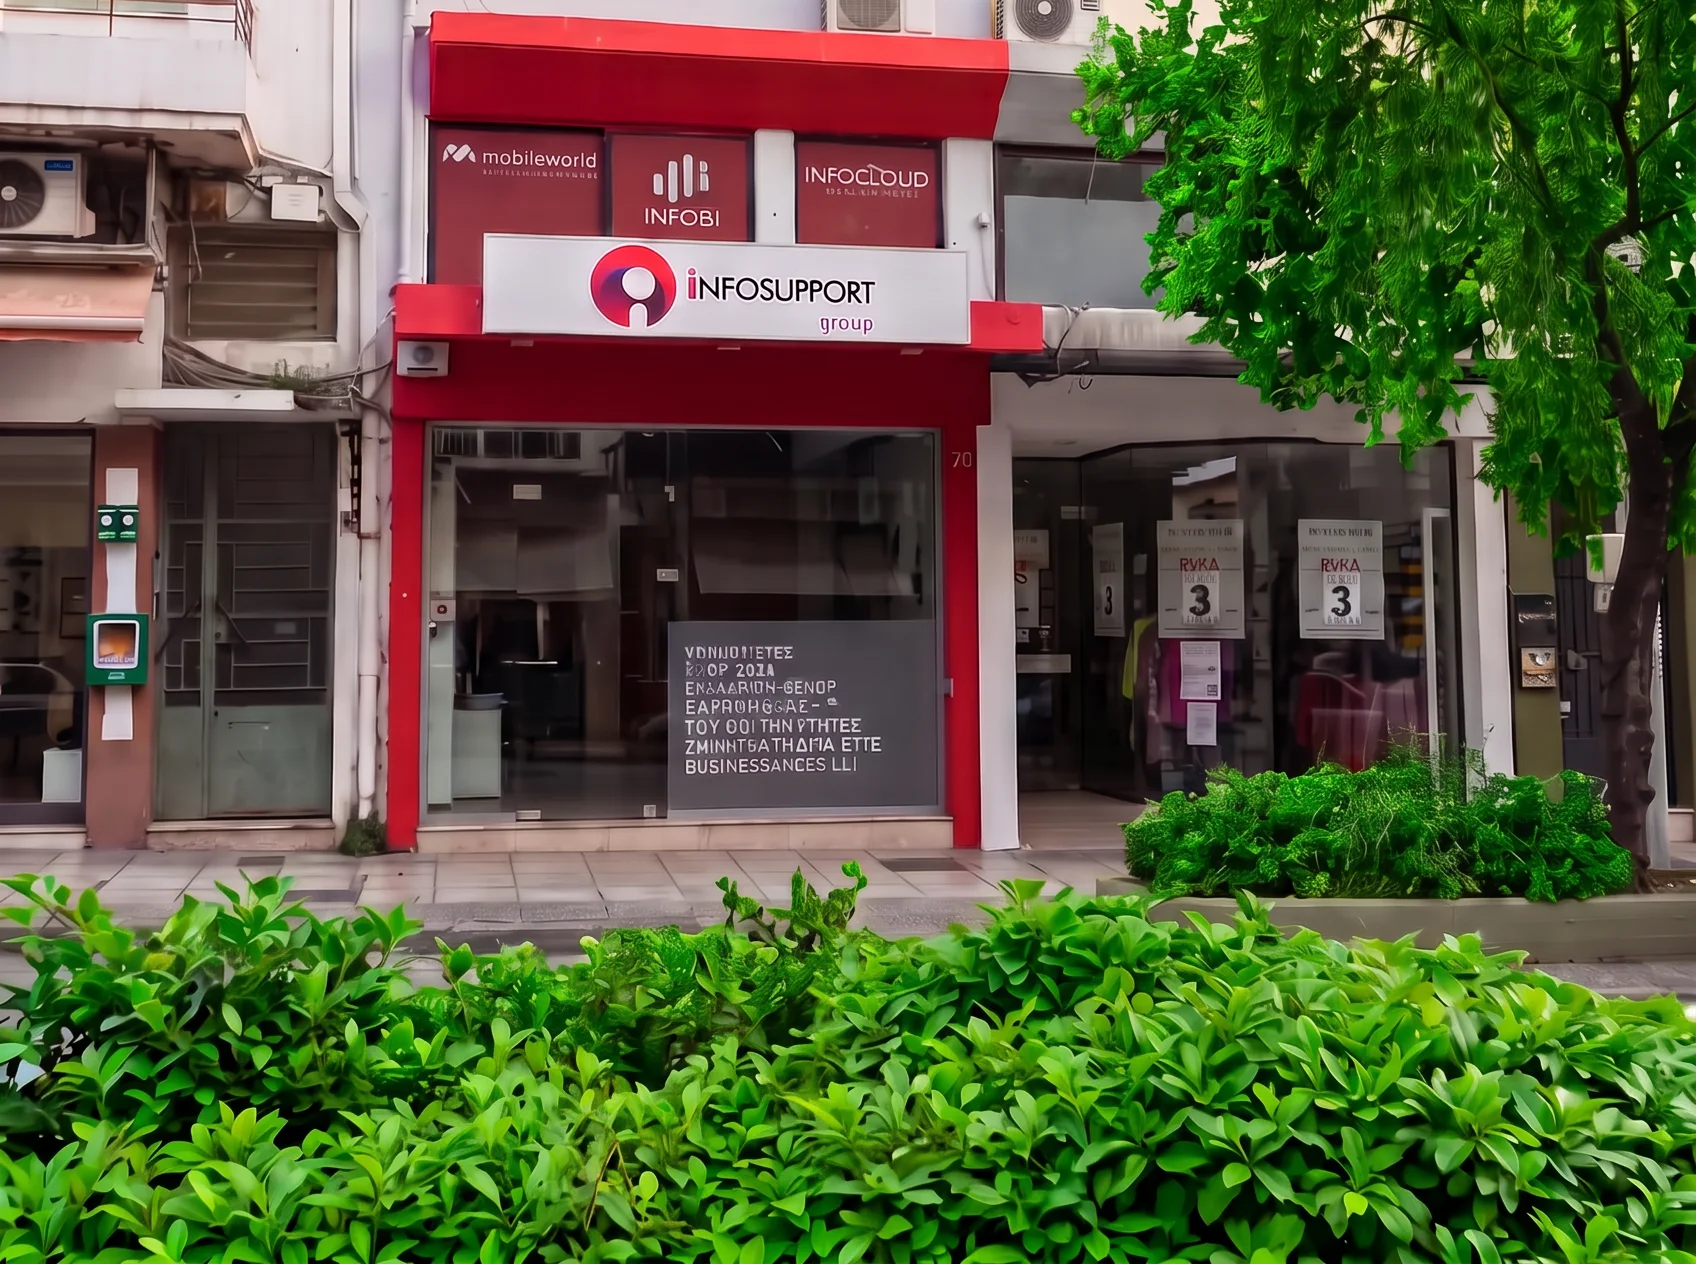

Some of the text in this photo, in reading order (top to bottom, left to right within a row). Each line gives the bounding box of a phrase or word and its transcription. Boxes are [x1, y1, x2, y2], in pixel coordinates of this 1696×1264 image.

[482, 149, 597, 168] mobileworld
[805, 164, 929, 188] INFOCLOUD
[644, 207, 719, 227] INFOBI
[820, 317, 873, 335] group
[951, 451, 972, 468] 70
[1189, 584, 1211, 616] 3
[1331, 585, 1352, 617] 3
[685, 757, 826, 775] BUSINESSANCES
